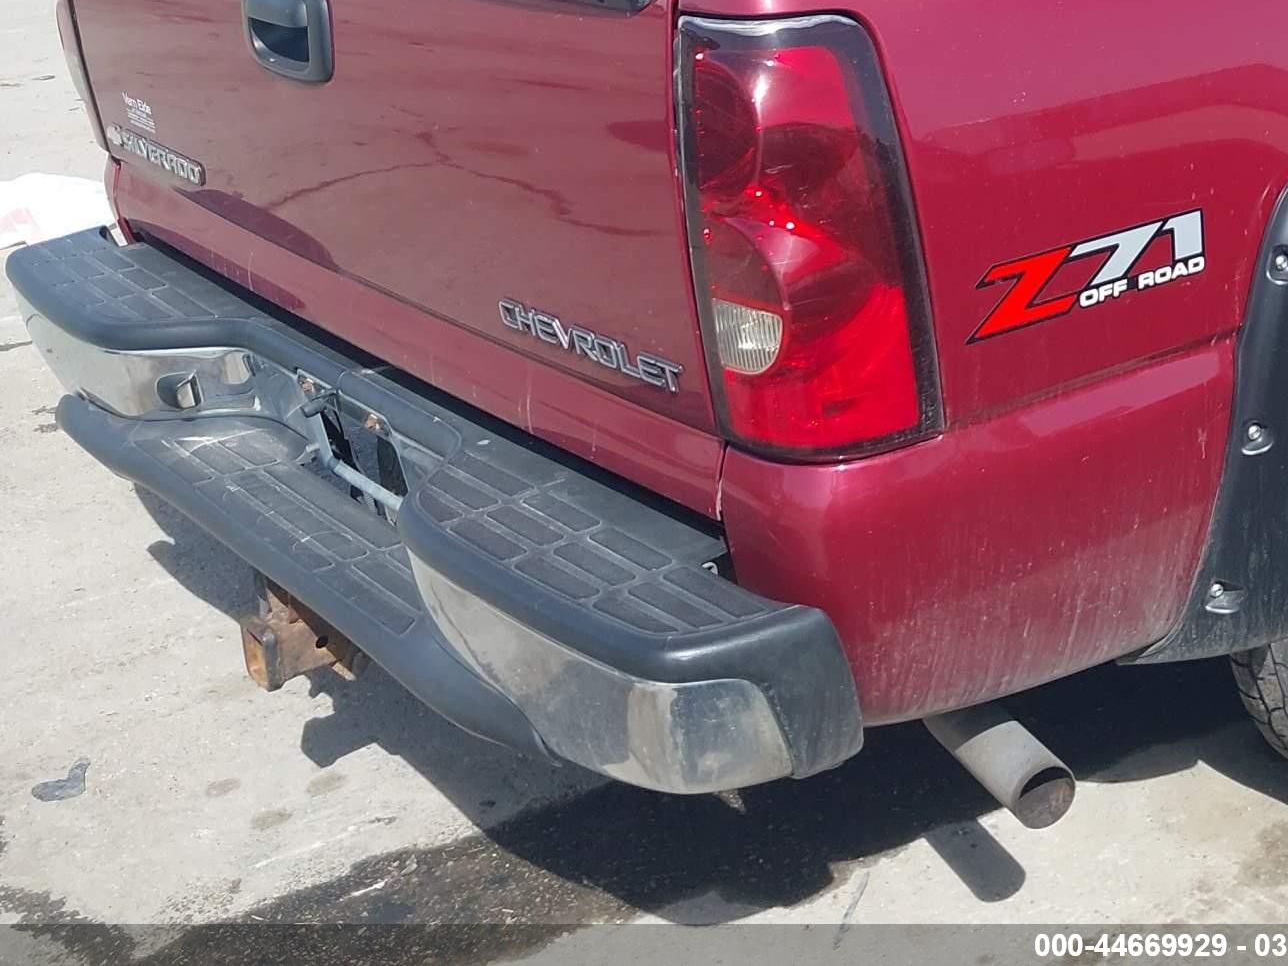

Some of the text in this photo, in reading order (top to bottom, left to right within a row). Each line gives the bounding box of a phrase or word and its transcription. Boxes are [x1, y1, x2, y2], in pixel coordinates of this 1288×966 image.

[121, 130, 202, 185] SILVERADO
[966, 208, 1204, 345] Z71
[1079, 256, 1206, 308] OFF ROAD
[498, 297, 685, 394] CHEVROLET
